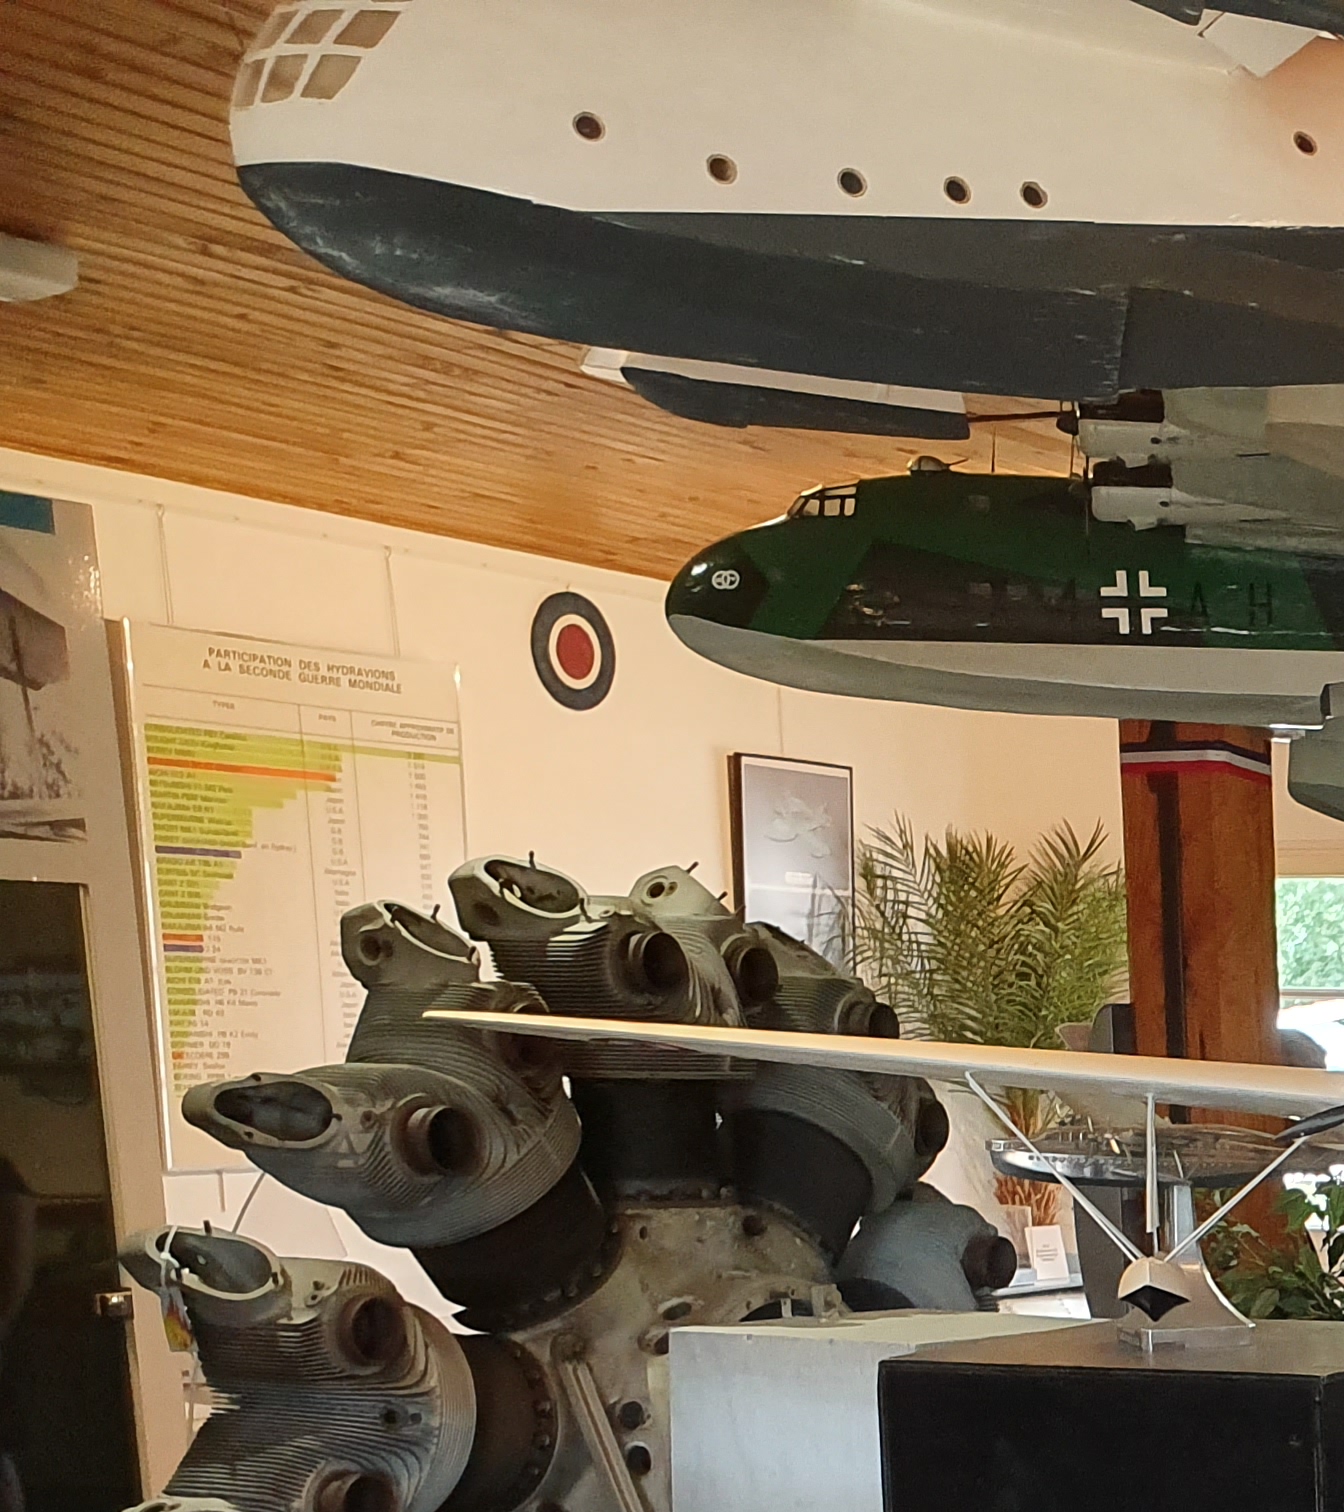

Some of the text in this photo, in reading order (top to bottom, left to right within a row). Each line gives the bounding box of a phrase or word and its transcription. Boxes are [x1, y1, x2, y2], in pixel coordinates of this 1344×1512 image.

[202, 659, 402, 695] A LA SECONDE GUERRE MONDIALE
[208, 647, 396, 681] PARTICIPATION DES HYDRAVIONS
